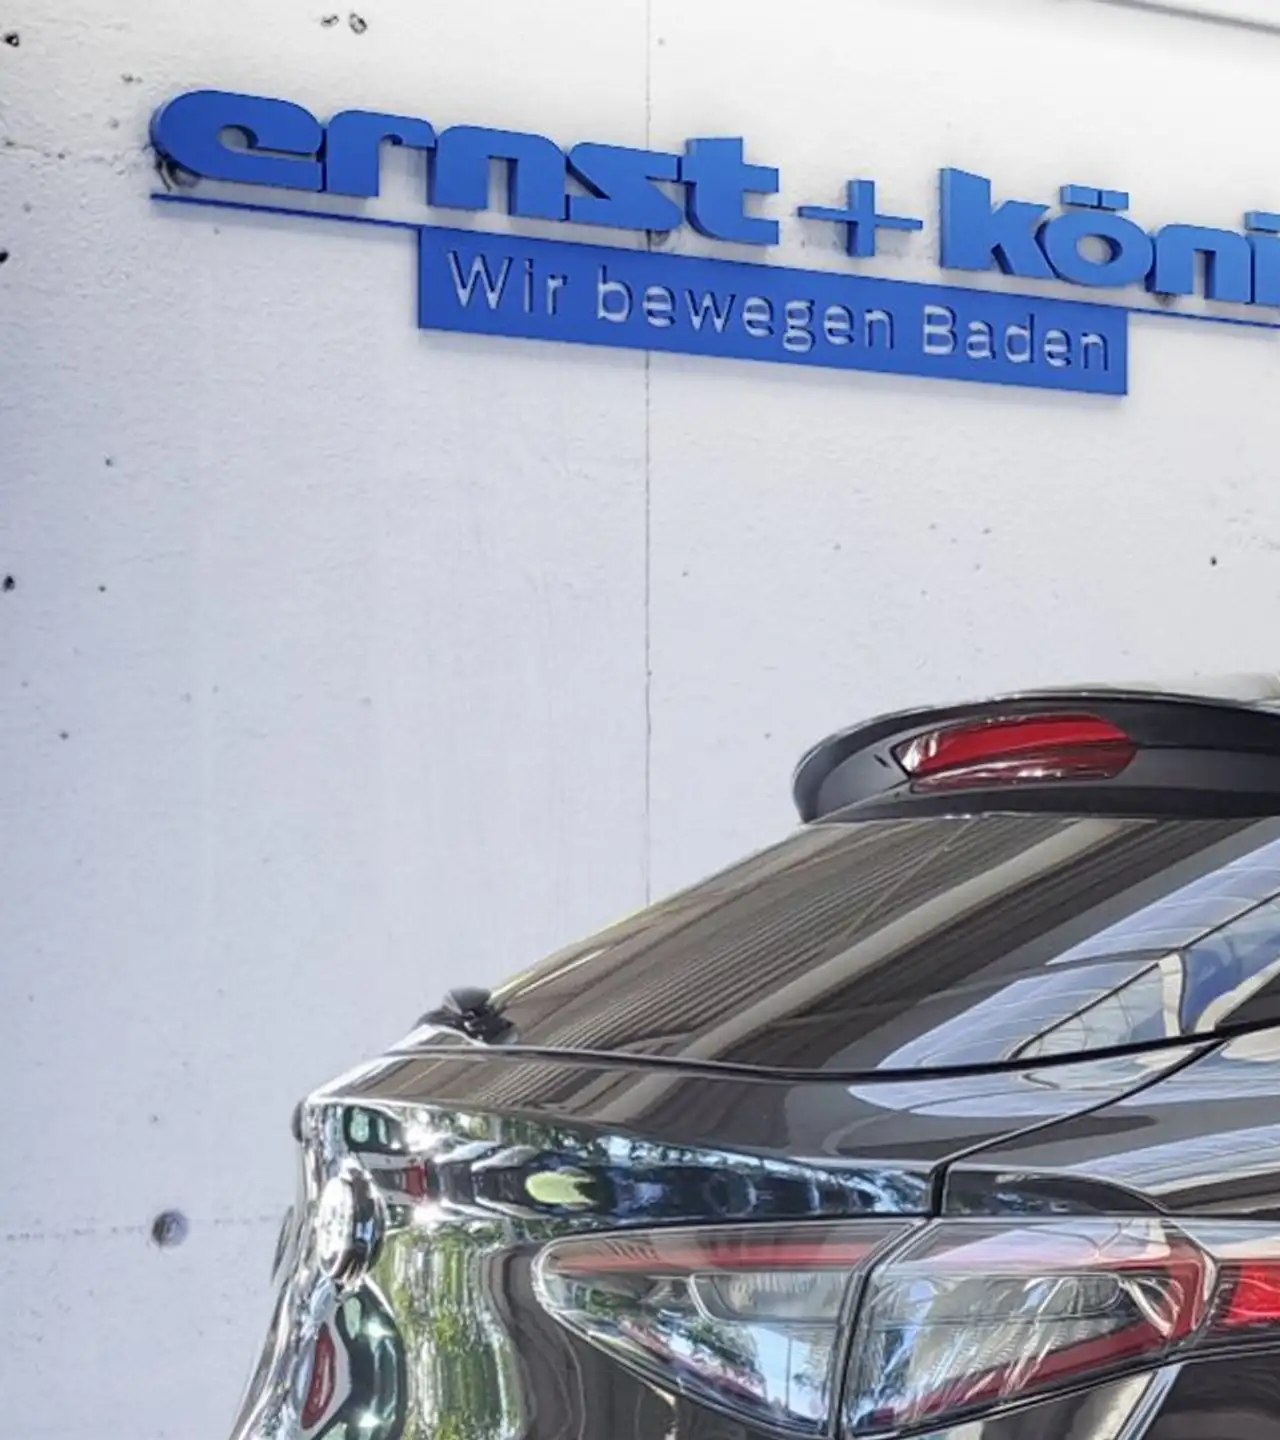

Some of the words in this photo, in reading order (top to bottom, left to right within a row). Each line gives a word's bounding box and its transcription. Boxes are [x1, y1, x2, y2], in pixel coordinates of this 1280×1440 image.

[149, 89, 780, 246] ernst
[447, 248, 568, 317] Wir
[597, 265, 895, 353] bewegen
[921, 304, 1110, 370] Baden
